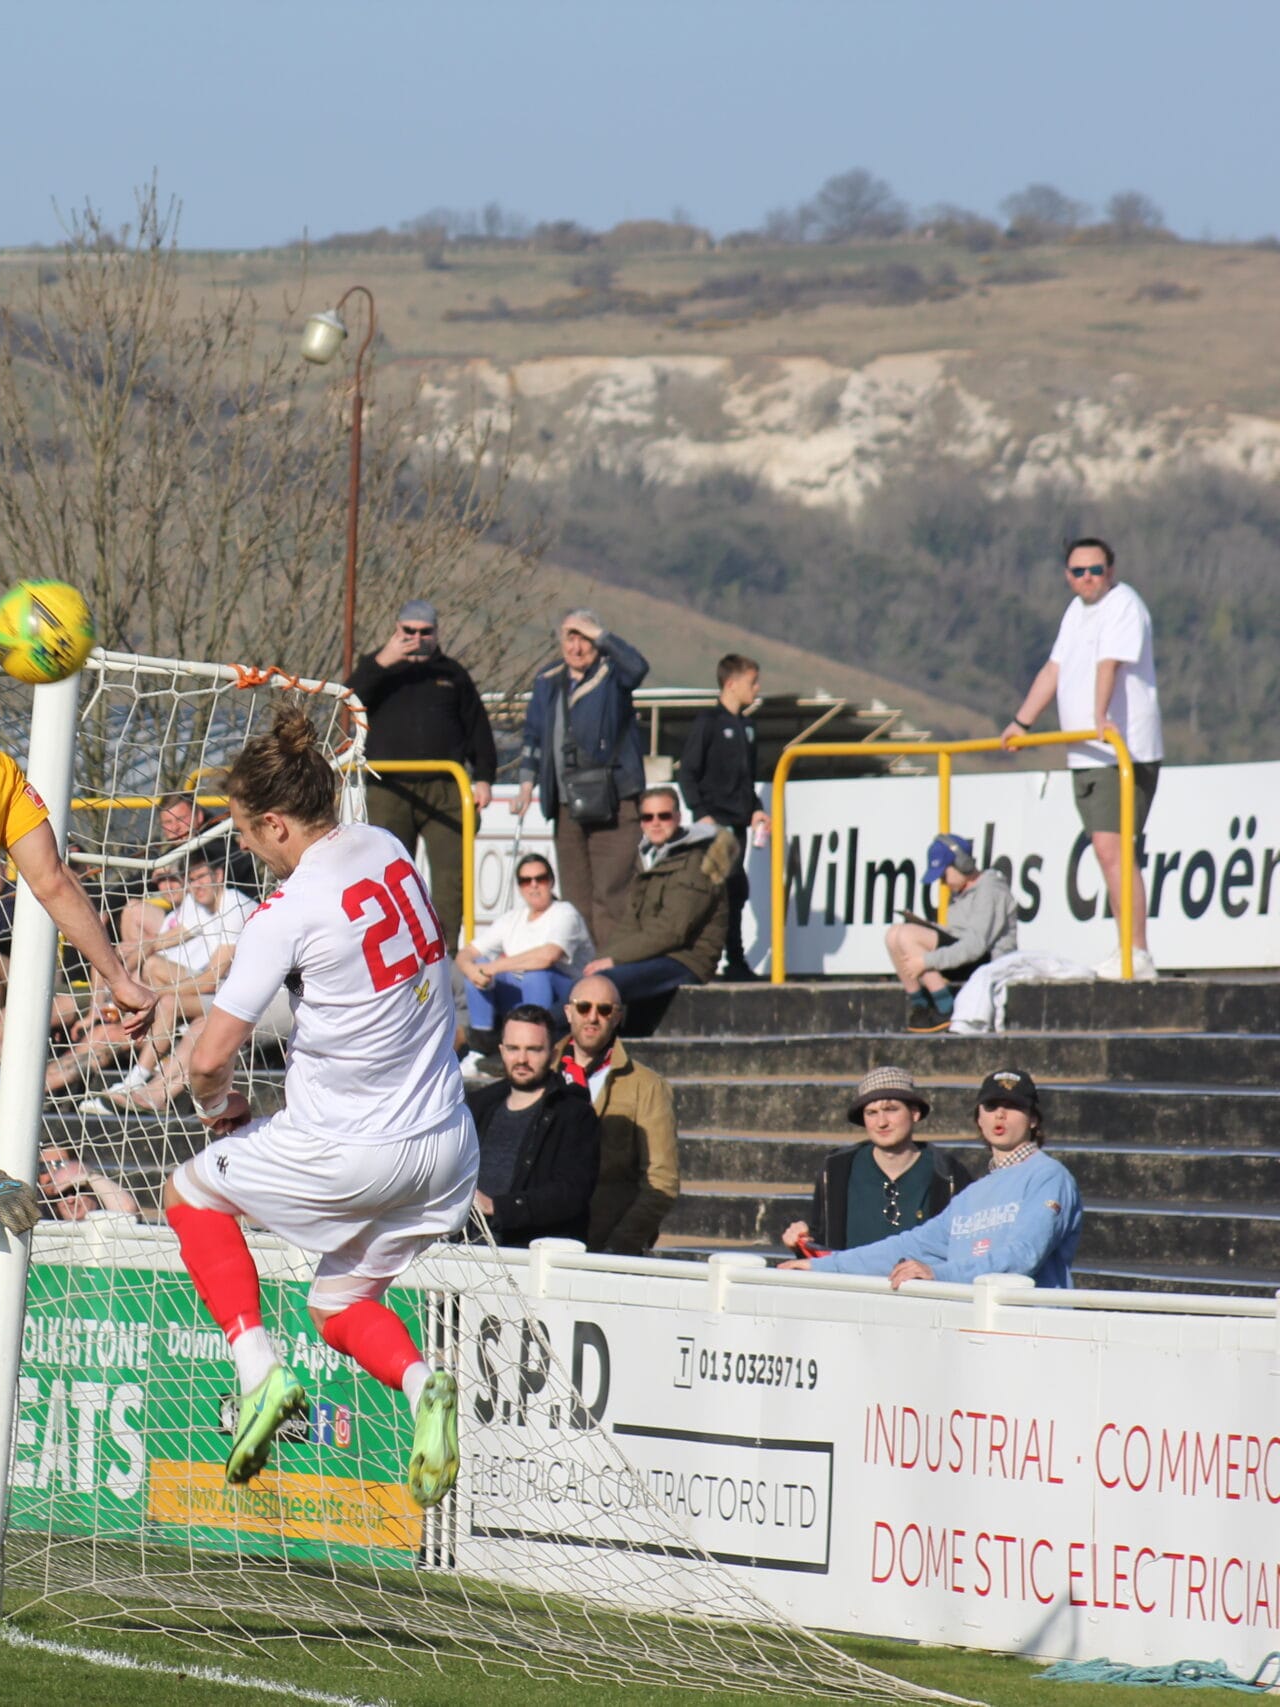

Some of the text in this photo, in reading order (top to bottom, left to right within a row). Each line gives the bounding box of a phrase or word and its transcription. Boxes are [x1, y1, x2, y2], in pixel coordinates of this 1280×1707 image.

[341, 857, 447, 993] 20
[21, 1315, 149, 1371] OLKESTONE
[474, 1314, 611, 1431] S.P.D
[8, 1376, 145, 1500] EATS
[863, 1403, 1064, 1485] INDUSTRIAL
[471, 1453, 817, 1529] ELECTRICAL CONTRACTORS LTD
[872, 1520, 1055, 1605] DOMESTIC
